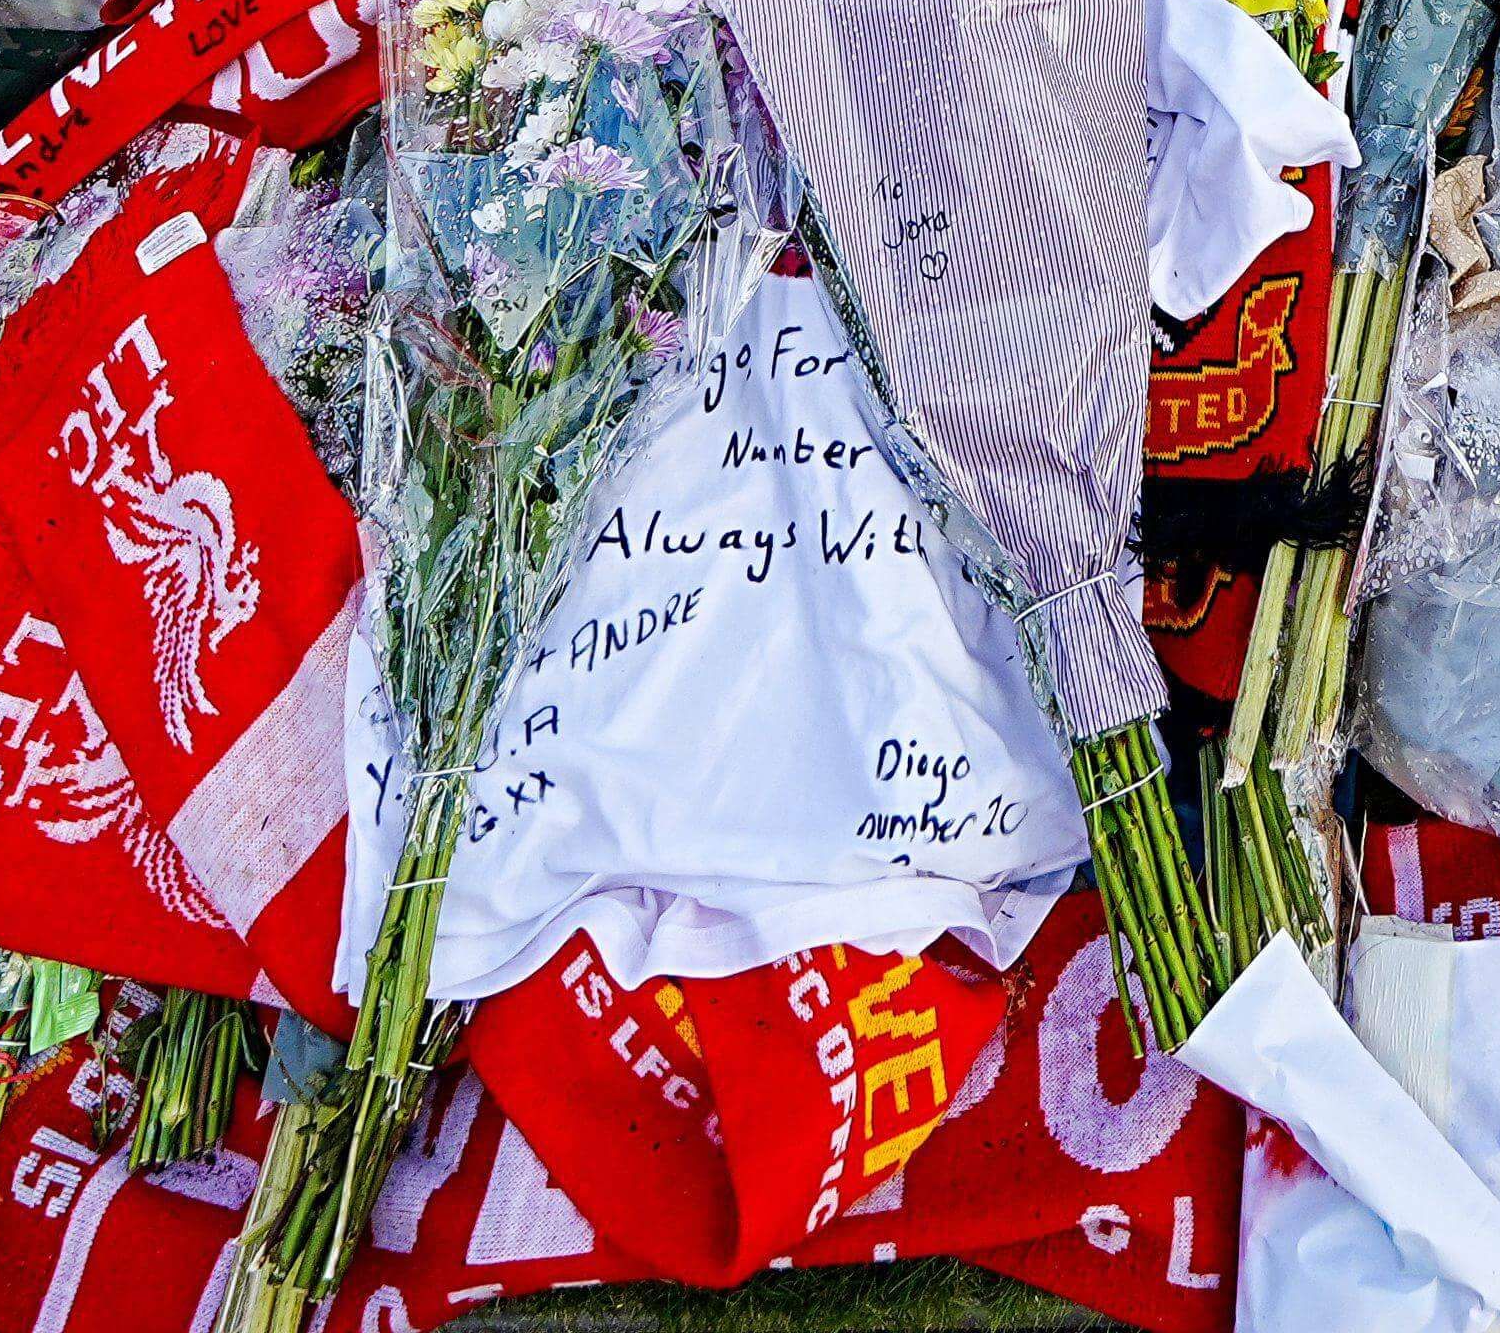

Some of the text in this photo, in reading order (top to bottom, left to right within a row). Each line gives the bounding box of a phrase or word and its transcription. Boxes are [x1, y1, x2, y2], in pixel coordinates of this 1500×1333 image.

[882, 208, 951, 251] Jota
[770, 325, 852, 380] For
[585, 508, 798, 584] Always
[568, 585, 708, 673] ANDRE
[874, 737, 973, 809] Diogo
[855, 797, 1030, 843] number 20
